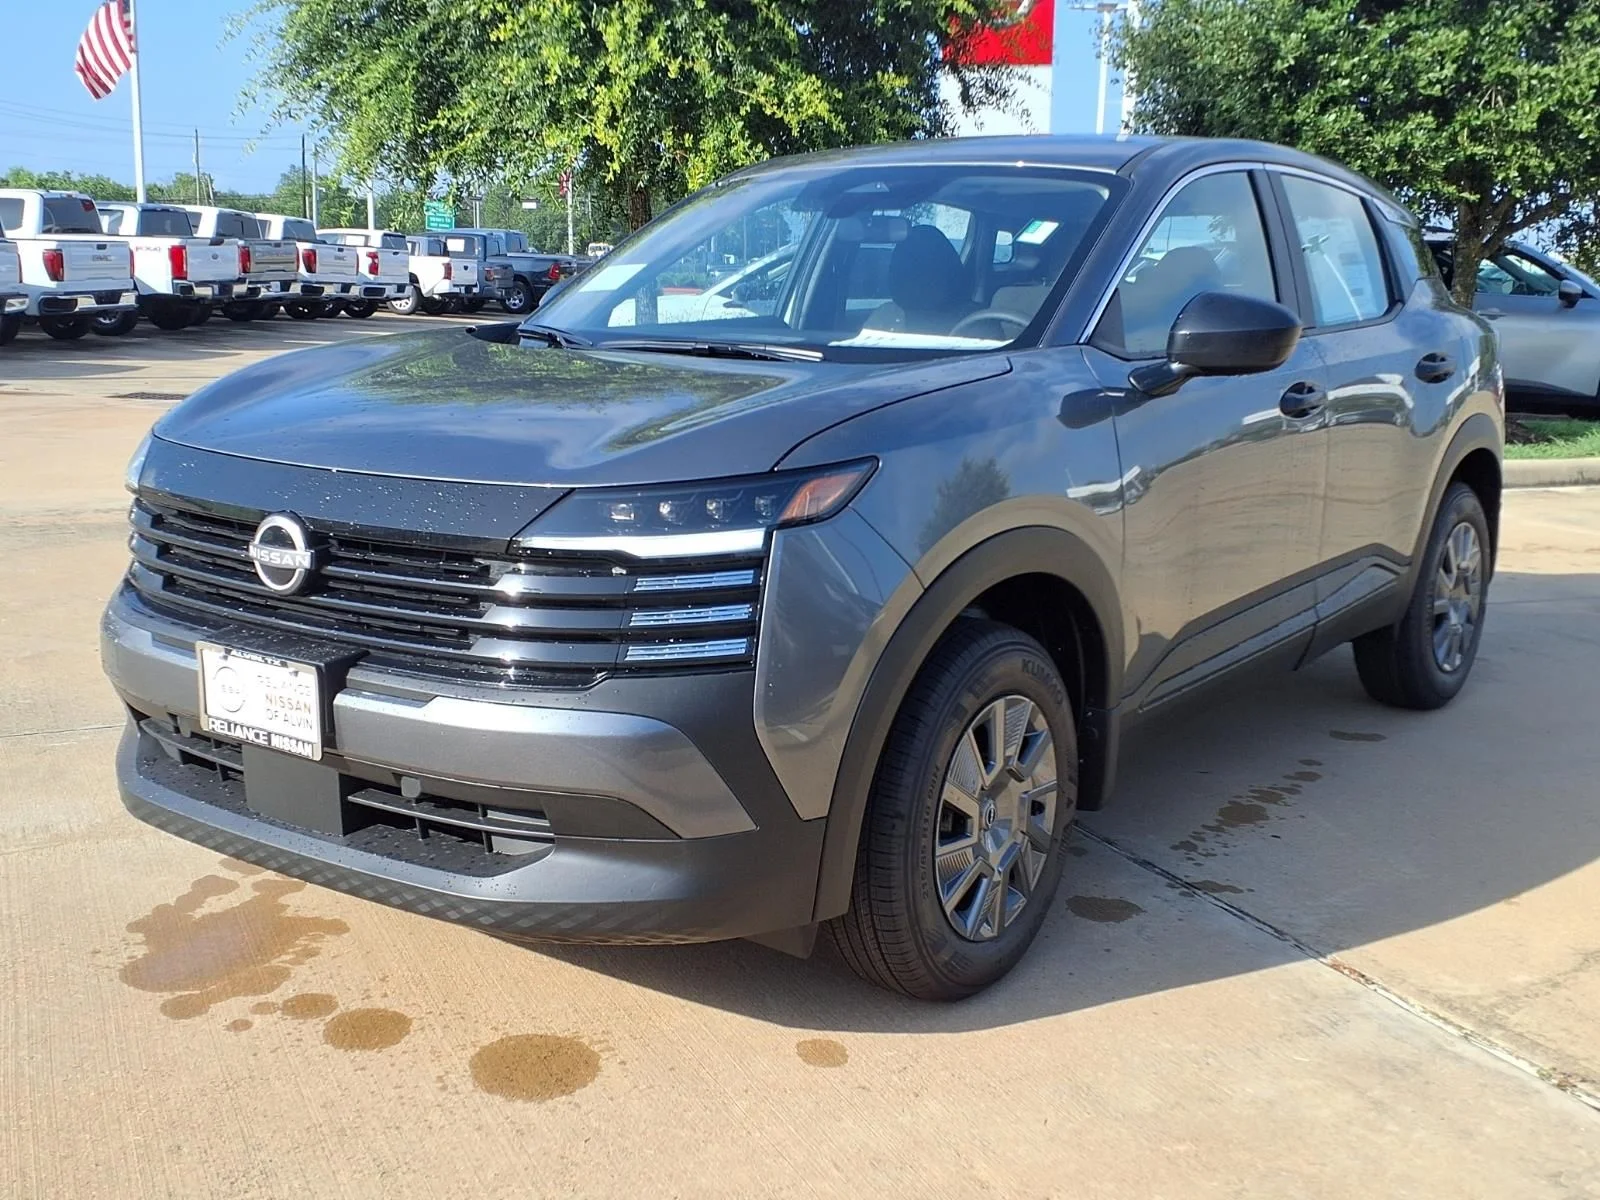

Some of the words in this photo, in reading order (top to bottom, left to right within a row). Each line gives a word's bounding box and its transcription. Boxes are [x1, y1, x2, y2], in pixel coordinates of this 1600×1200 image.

[249, 545, 310, 568] NISSAN
[265, 693, 312, 715] NISSAN
[265, 708, 279, 721] OF
[283, 712, 313, 730] ALVIN
[208, 718, 268, 744] RELIANCE
[270, 733, 312, 759] NISSAN
